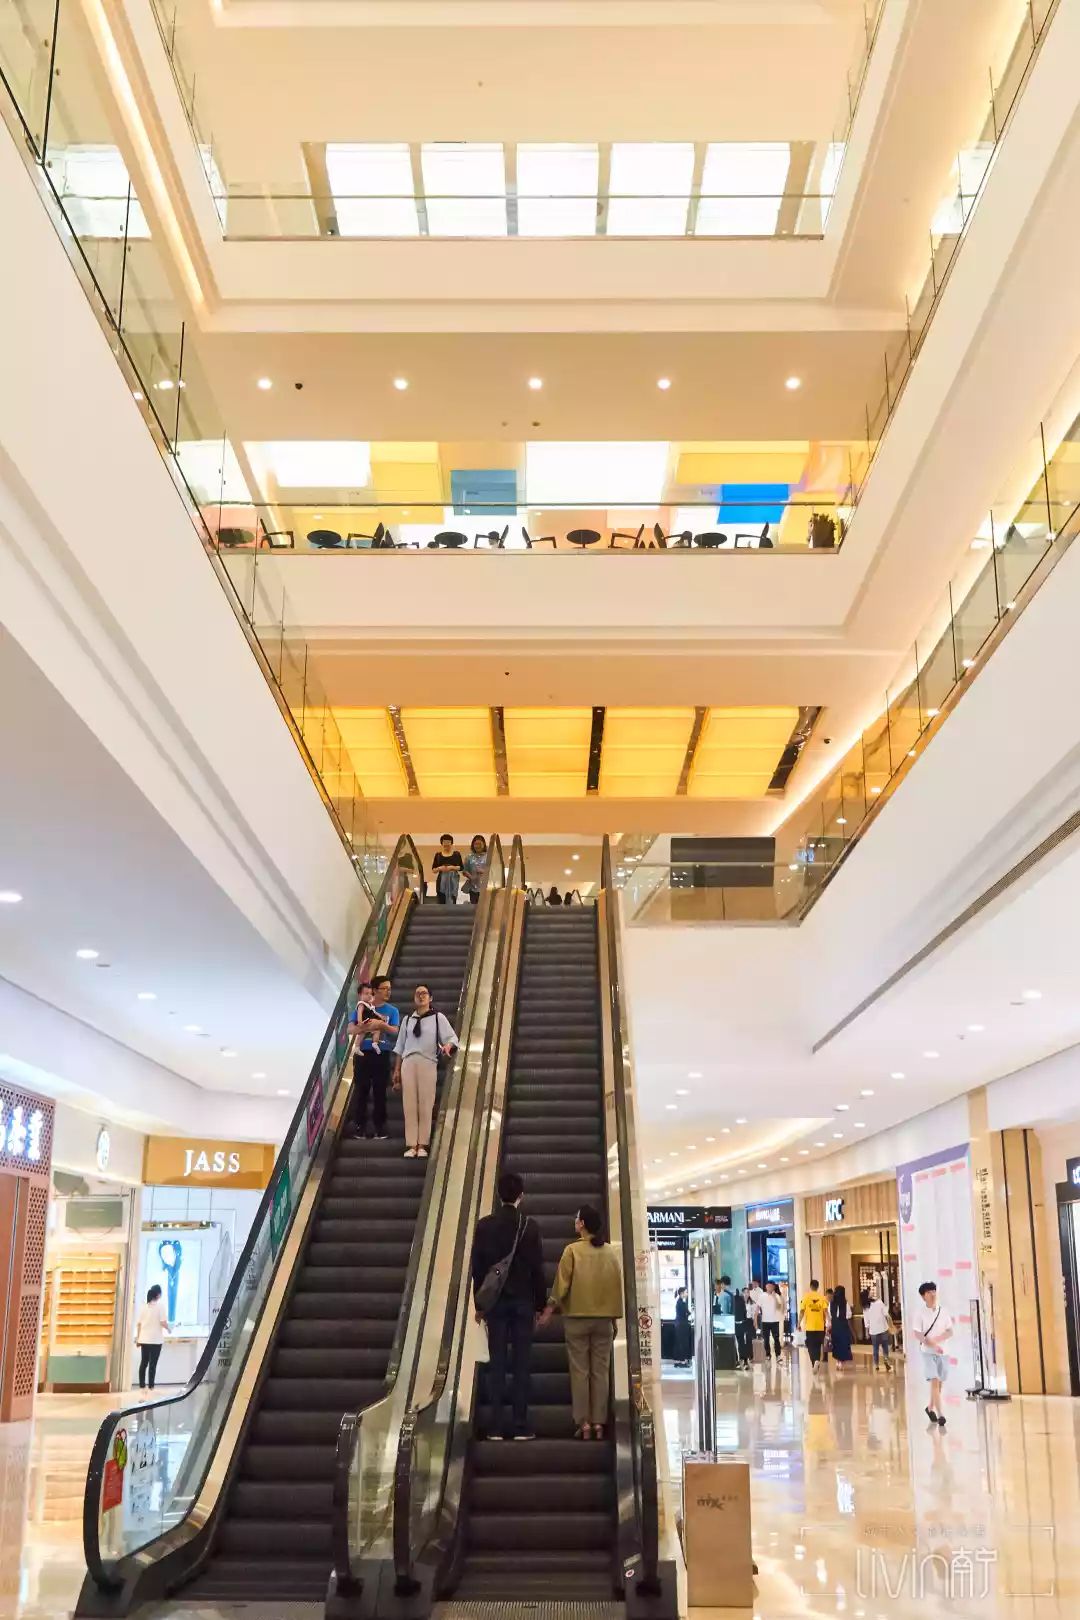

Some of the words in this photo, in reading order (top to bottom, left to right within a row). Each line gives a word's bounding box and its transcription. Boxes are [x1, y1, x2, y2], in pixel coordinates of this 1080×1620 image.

[183, 1149, 240, 1176] JASS
[647, 1211, 685, 1223] ARMANI
[825, 1198, 844, 1221] KFC
